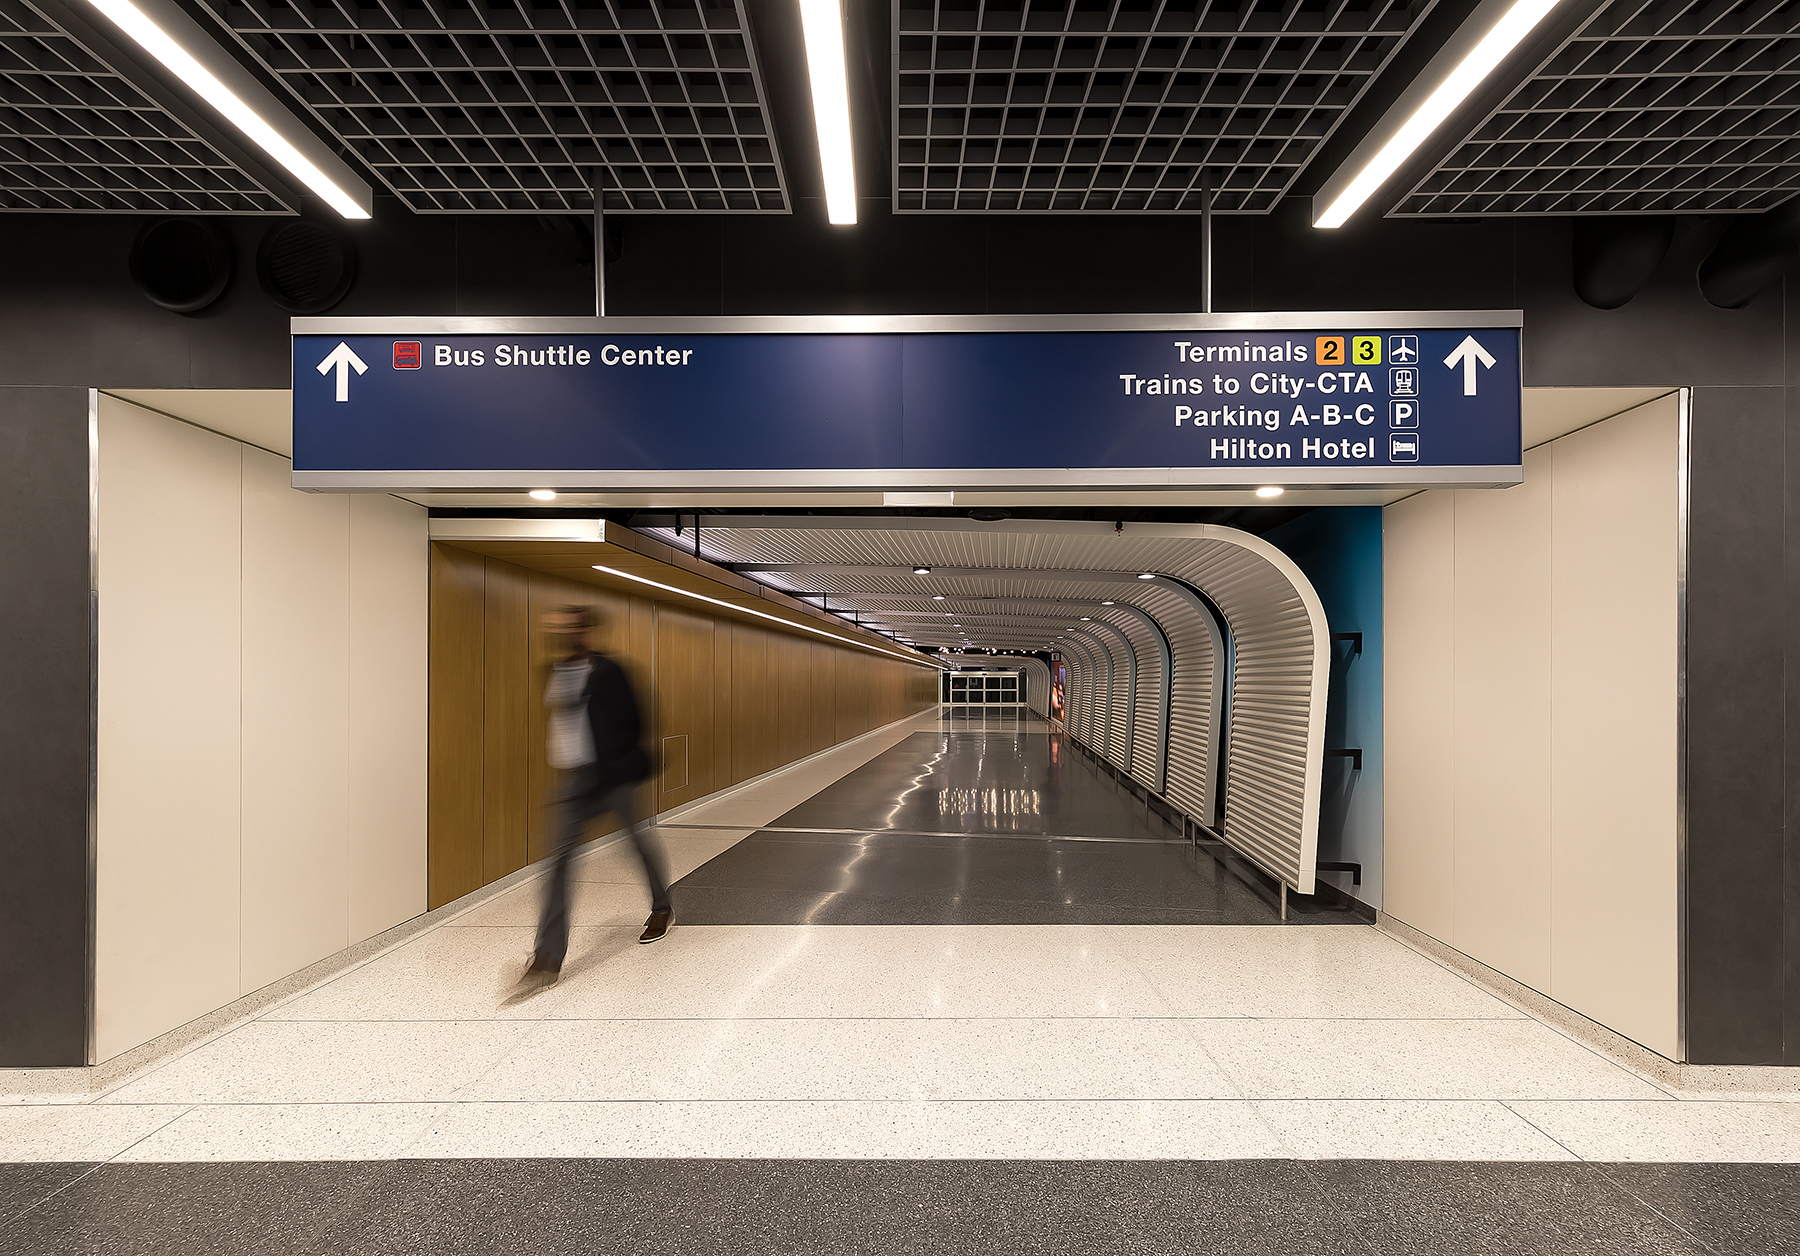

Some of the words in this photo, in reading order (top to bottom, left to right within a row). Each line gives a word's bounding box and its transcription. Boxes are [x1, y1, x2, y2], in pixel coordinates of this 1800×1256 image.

[434, 344, 485, 366] Bus
[494, 344, 591, 366] Shuttle
[600, 344, 693, 366] Center
[1174, 340, 1308, 363] Terminals
[1323, 340, 1338, 361] 2
[1359, 340, 1374, 361] 3
[1119, 373, 1203, 395] Trains
[1212, 374, 1240, 395] to
[1250, 371, 1374, 399] City-CTA
[1175, 405, 1280, 431] Parking
[1289, 403, 1375, 426] A-B-C
[1395, 403, 1413, 426] P
[1210, 438, 1291, 460] Hilton
[1302, 437, 1375, 459] Hotel
